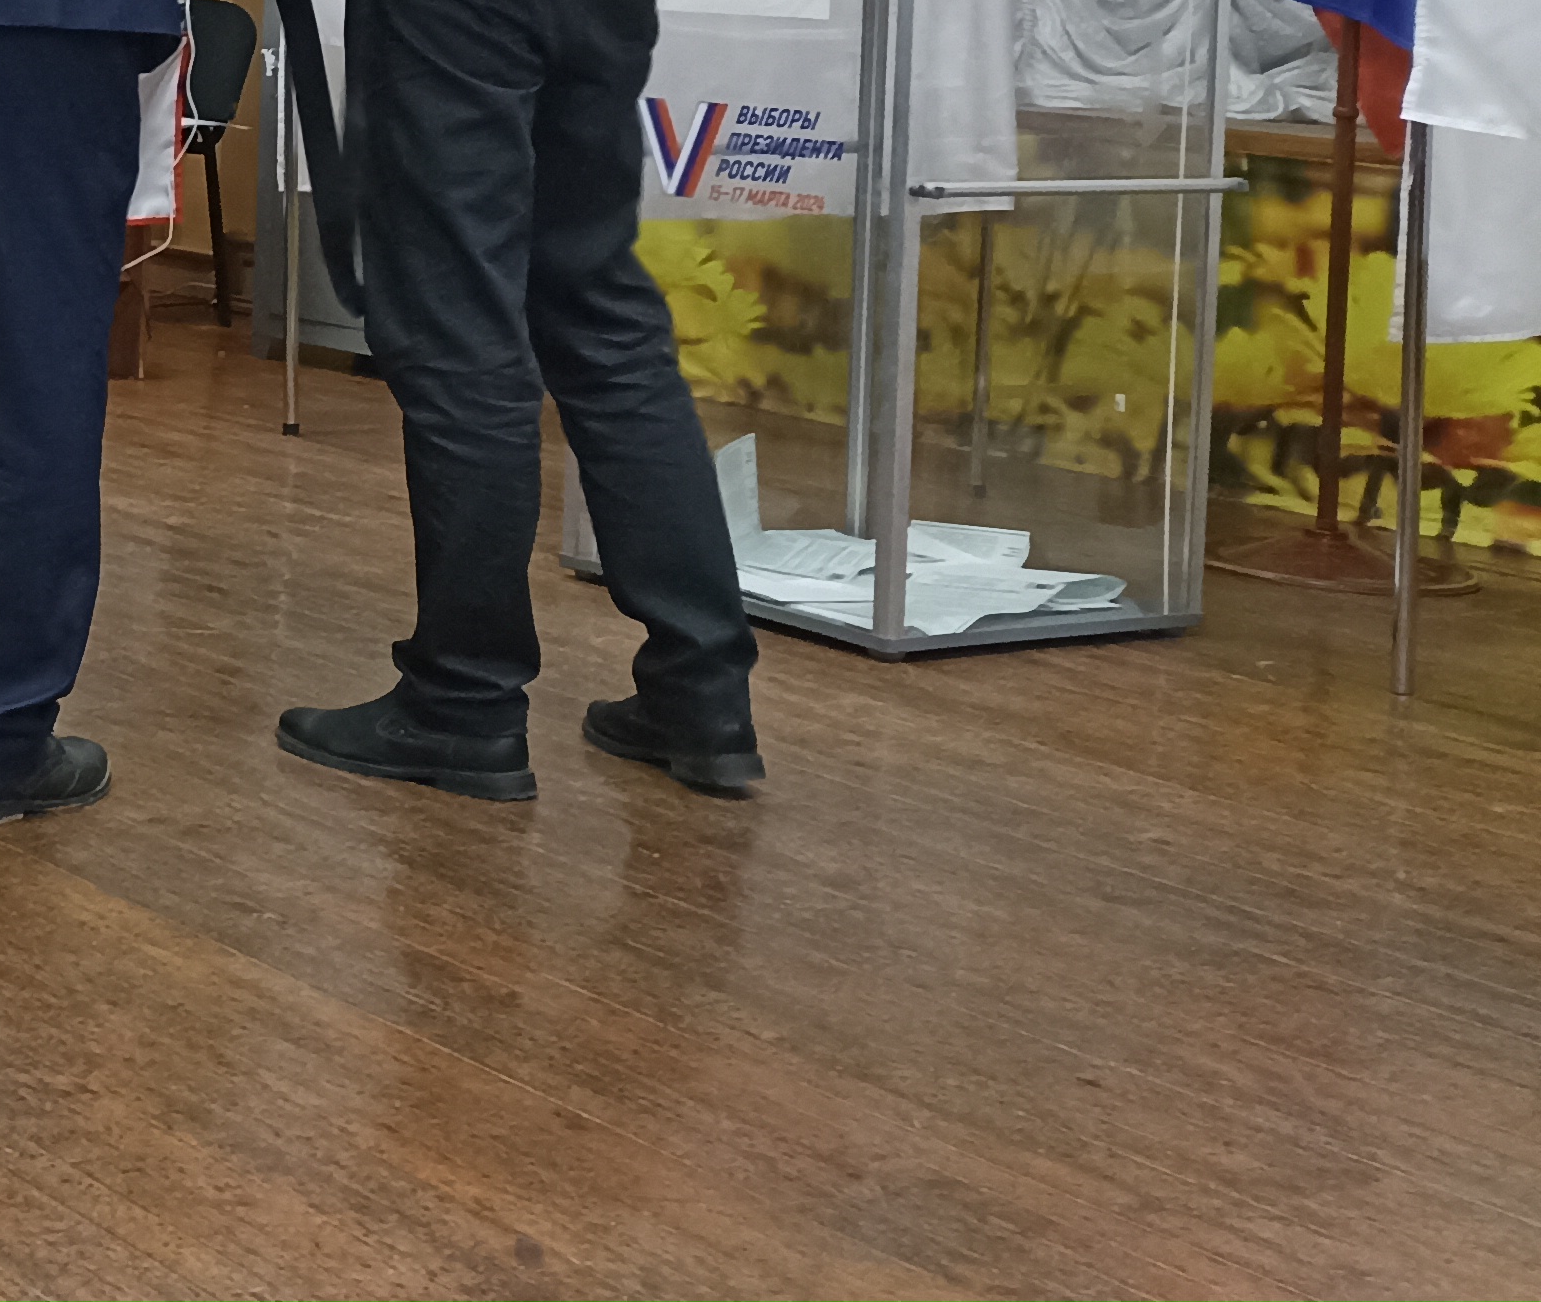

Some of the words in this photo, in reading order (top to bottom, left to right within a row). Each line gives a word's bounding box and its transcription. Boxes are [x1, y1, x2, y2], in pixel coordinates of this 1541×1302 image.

[735, 104, 821, 131] ВЫБОРЫ
[725, 132, 845, 161] ПРЕЗИДЕНТА
[714, 158, 792, 185] РОССИИ
[745, 188, 791, 209] МАРТА
[792, 193, 826, 212] 2024
